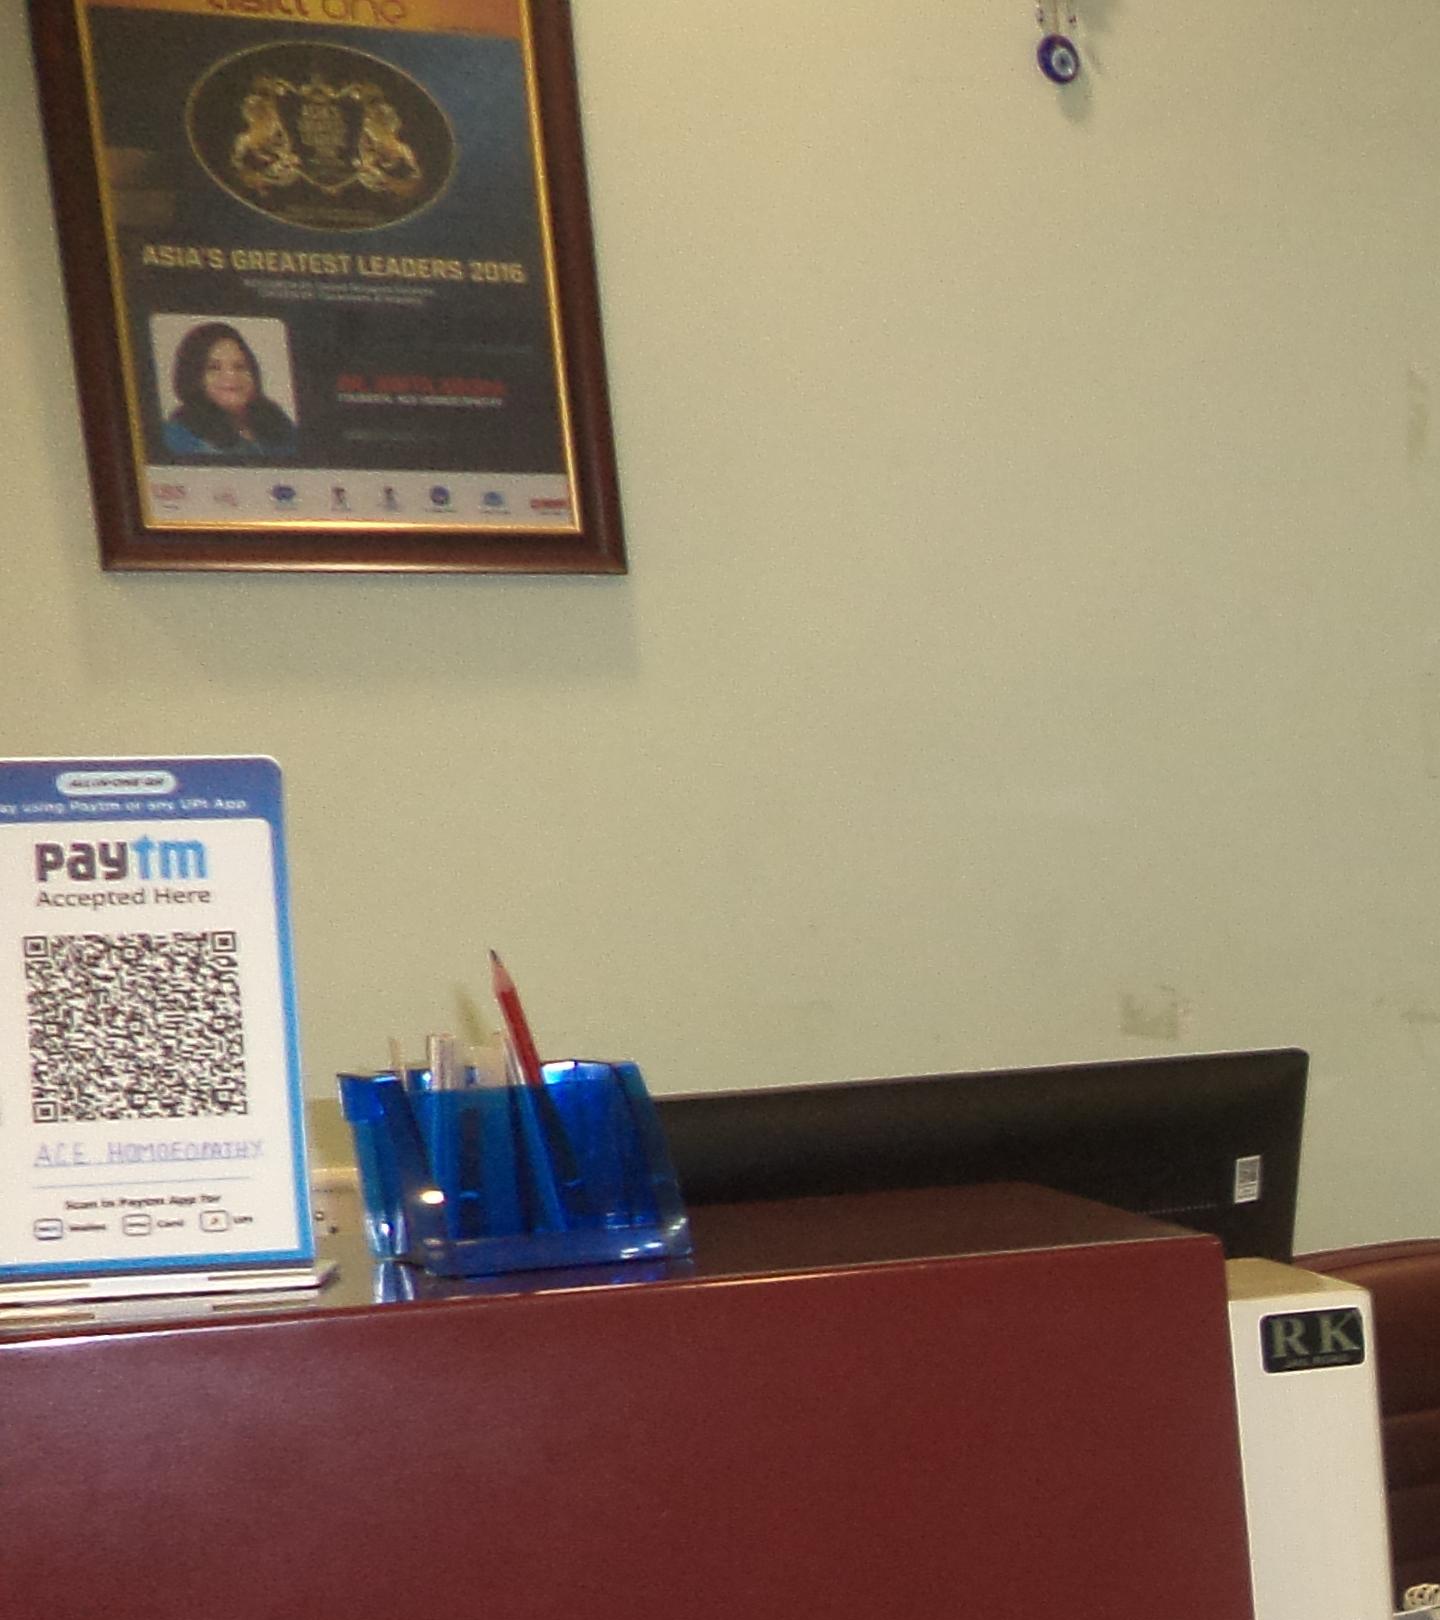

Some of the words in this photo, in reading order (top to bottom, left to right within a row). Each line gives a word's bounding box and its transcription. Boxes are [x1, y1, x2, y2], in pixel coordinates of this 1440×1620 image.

[142, 245, 224, 270] ASIA'S
[231, 248, 352, 275] GREATEST
[356, 255, 463, 281] LEADERS
[469, 259, 526, 284] 2016
[36, 888, 145, 910] Accepted
[154, 887, 211, 904] Here
[36, 1143, 87, 1165] ACE
